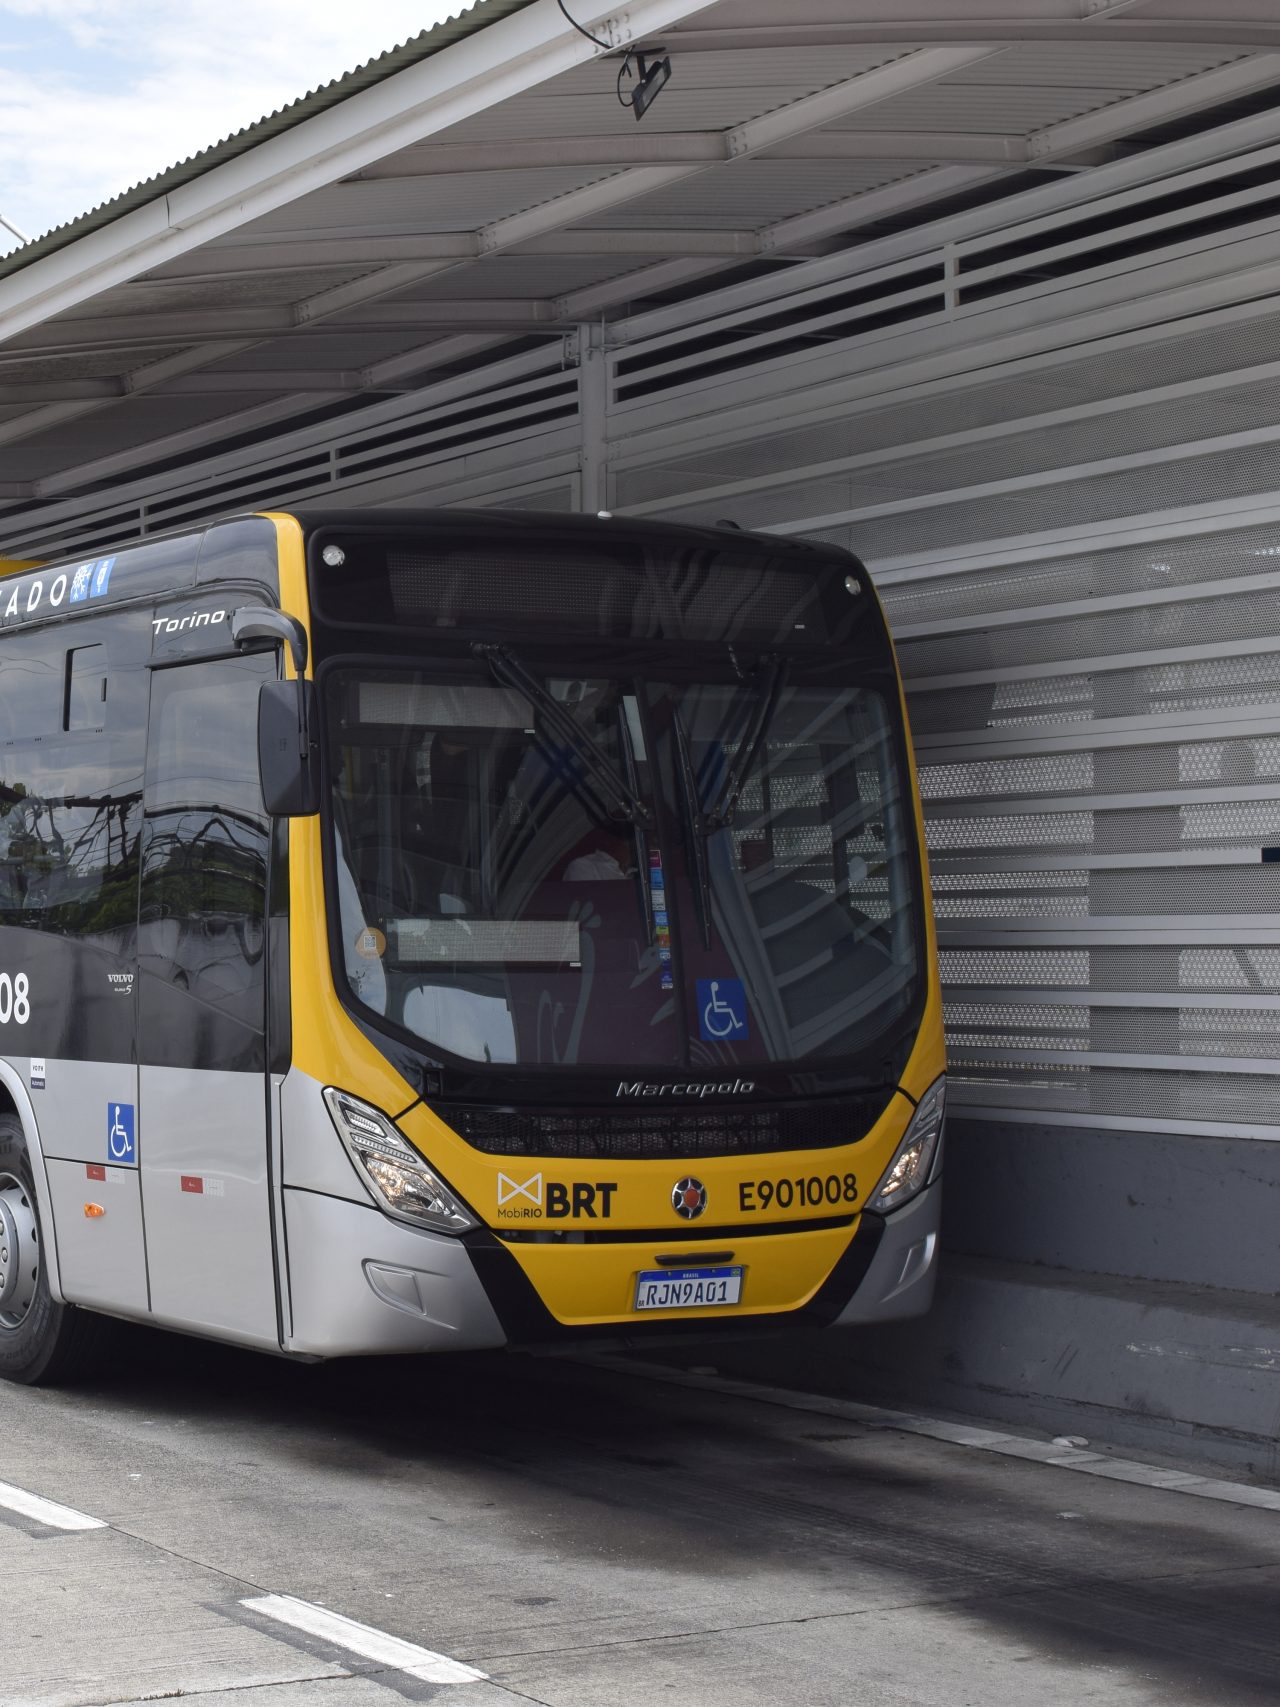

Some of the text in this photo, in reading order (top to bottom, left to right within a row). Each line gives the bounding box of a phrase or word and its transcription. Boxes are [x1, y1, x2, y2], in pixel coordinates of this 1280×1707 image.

[152, 610, 226, 635] Torino
[107, 974, 134, 983] VOLVO
[615, 1078, 756, 1098] Marcopolo
[545, 1182, 618, 1218] BRT
[738, 1172, 858, 1212] E901008
[497, 1207, 543, 1219] MobiRIO
[646, 1281, 727, 1305] RJN9A01
